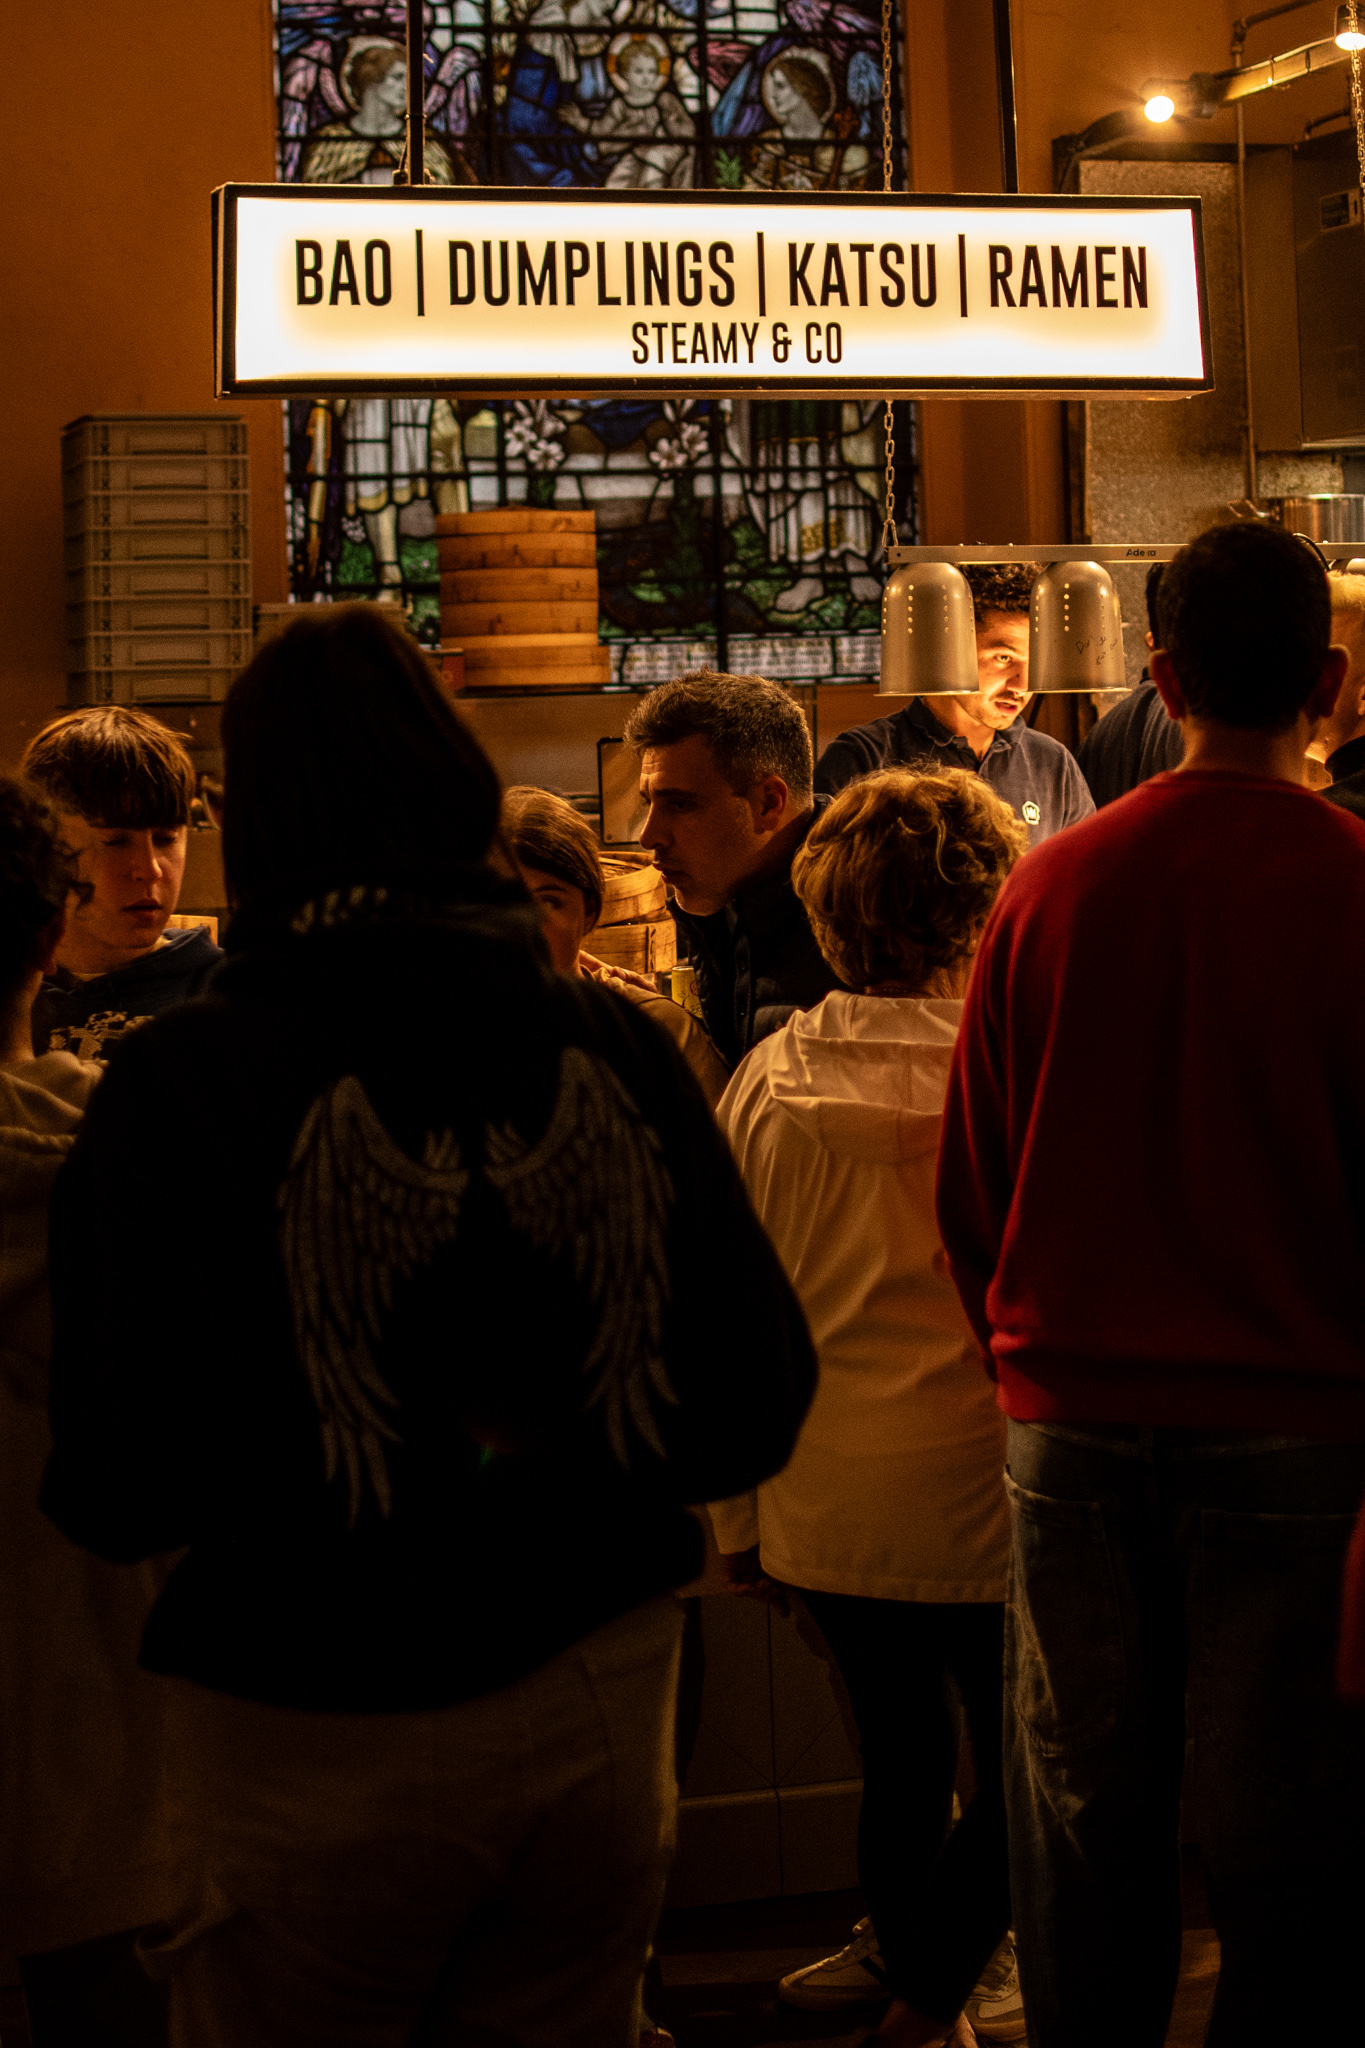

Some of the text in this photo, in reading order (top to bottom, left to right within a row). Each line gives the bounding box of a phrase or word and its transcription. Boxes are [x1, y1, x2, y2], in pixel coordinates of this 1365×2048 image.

[295, 239, 1148, 309] BAO DUMPLINGS KATSU RAMEN
[632, 321, 842, 365] STEAMY & CO
